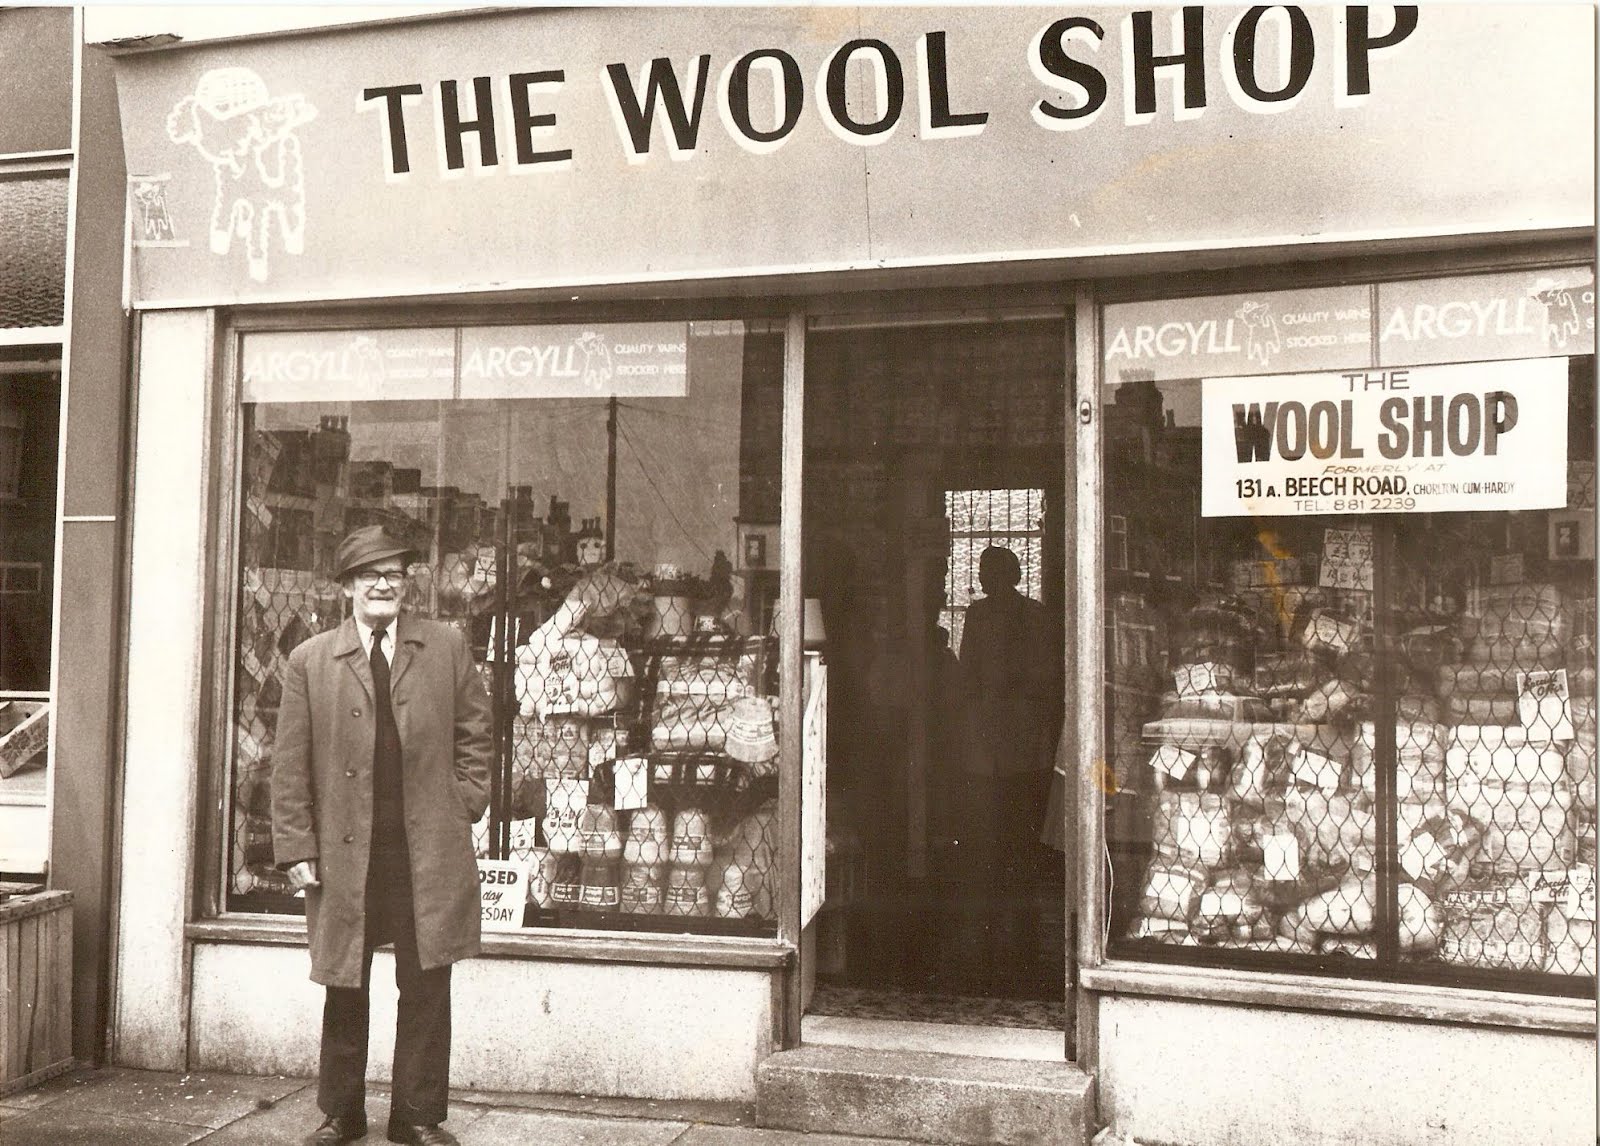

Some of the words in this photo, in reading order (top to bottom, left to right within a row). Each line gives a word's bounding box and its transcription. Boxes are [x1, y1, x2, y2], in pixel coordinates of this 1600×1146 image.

[357, 69, 573, 180] THE
[602, 31, 989, 163] WOOL
[1028, 5, 1419, 131] SHOP
[1282, 312, 1329, 325] QUALITY
[1334, 309, 1371, 321] YARNS
[1379, 296, 1537, 342] ARGYLL
[1105, 318, 1241, 360] ARGYLL
[1286, 335, 1338, 348] STOCKED
[613, 344, 654, 355] QUALITY
[657, 343, 686, 353] YARNS
[243, 350, 352, 382] ARGYLL
[460, 345, 580, 378] ARGYLL
[616, 365, 659, 376] STOCKED
[1342, 371, 1410, 392] THE
[1232, 400, 1364, 463] WOOL
[1377, 390, 1519, 460] SHOP
[1322, 463, 1419, 475] FORMERLY
[1424, 463, 1448, 473] AT
[1236, 479, 1262, 498] 131
[1286, 477, 1347, 497] BEECH
[1413, 483, 1459, 496] CHORLTON
[1334, 499, 1364, 511] 881
[1370, 497, 1416, 510] 2239
[479, 870, 518, 885] OSED
[482, 890, 504, 906] day
[480, 906, 514, 922] ESDAY
